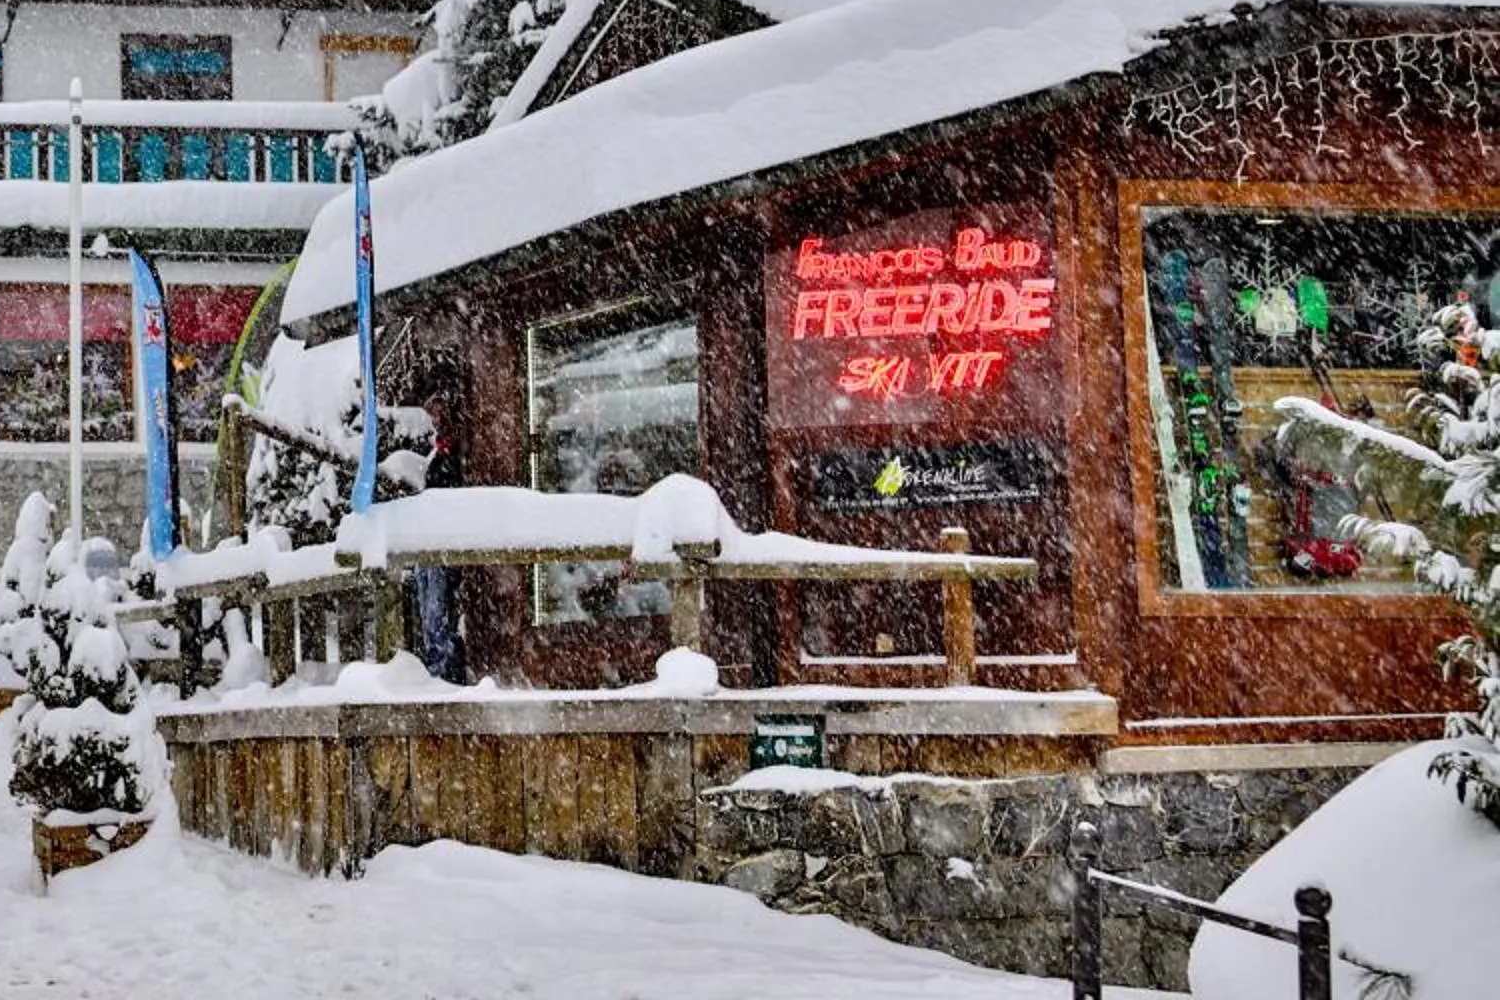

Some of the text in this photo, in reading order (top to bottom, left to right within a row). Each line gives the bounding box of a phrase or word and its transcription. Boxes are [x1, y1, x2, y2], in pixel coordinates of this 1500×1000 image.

[793, 278, 1056, 341] FREERIDE
[837, 350, 1003, 400] SKI VTT
